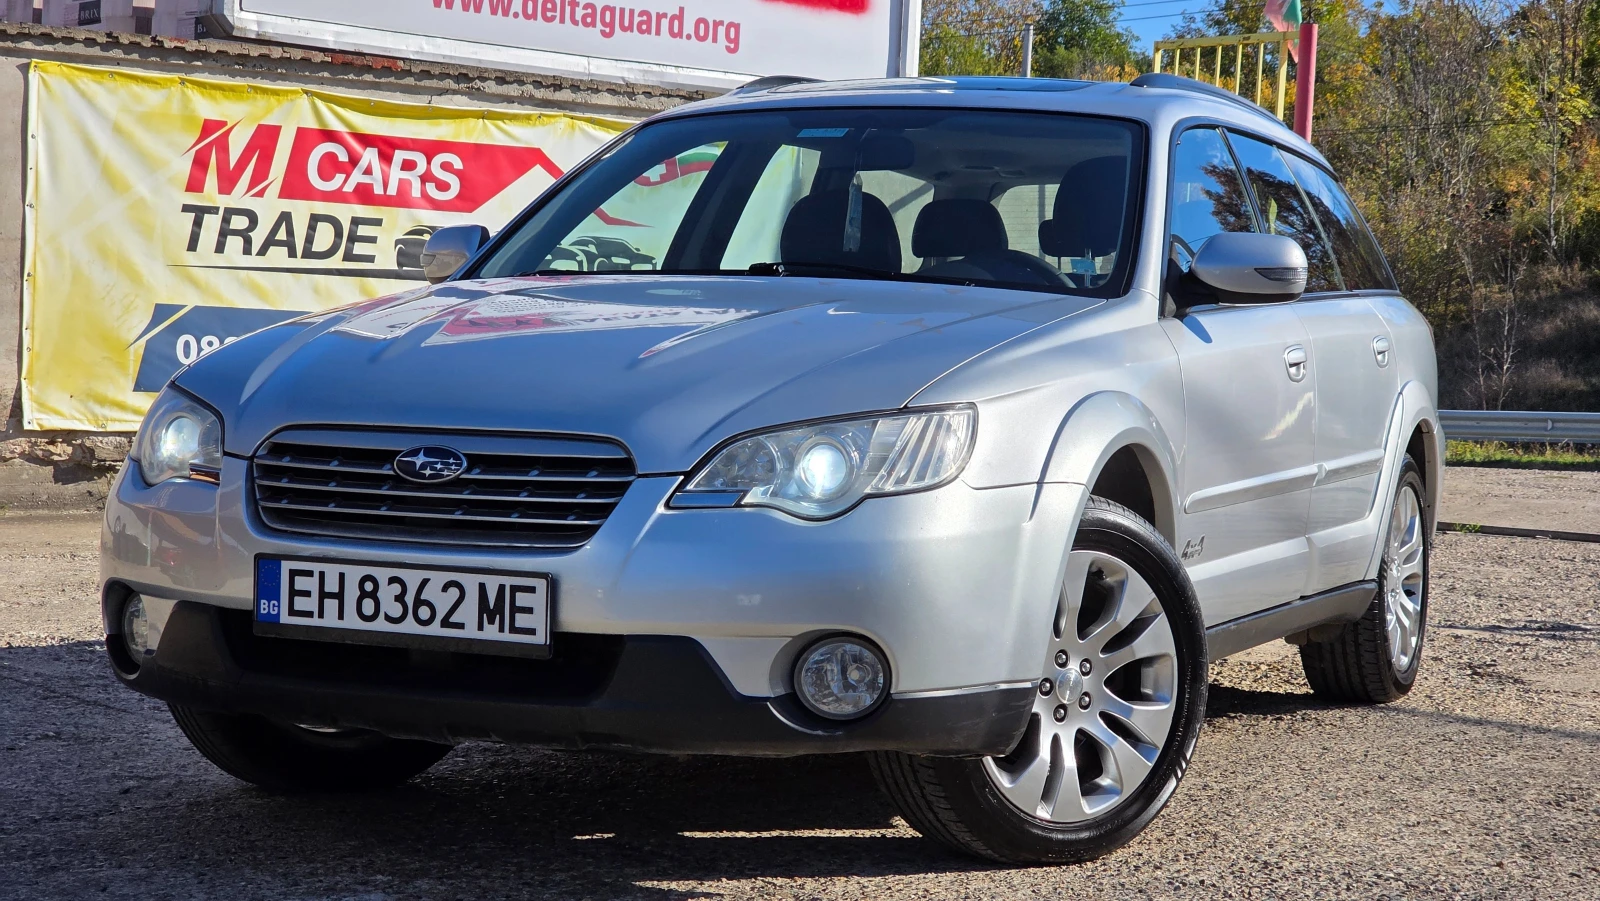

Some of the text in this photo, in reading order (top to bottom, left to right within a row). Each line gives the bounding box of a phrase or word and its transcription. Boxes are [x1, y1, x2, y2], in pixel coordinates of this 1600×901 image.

[80, 8, 99, 20] BRIX
[181, 117, 464, 200] M CARS
[181, 203, 384, 264] TRADE
[176, 334, 239, 365] 08
[260, 599, 279, 615] BG
[288, 568, 537, 636] EH 8362 ME
